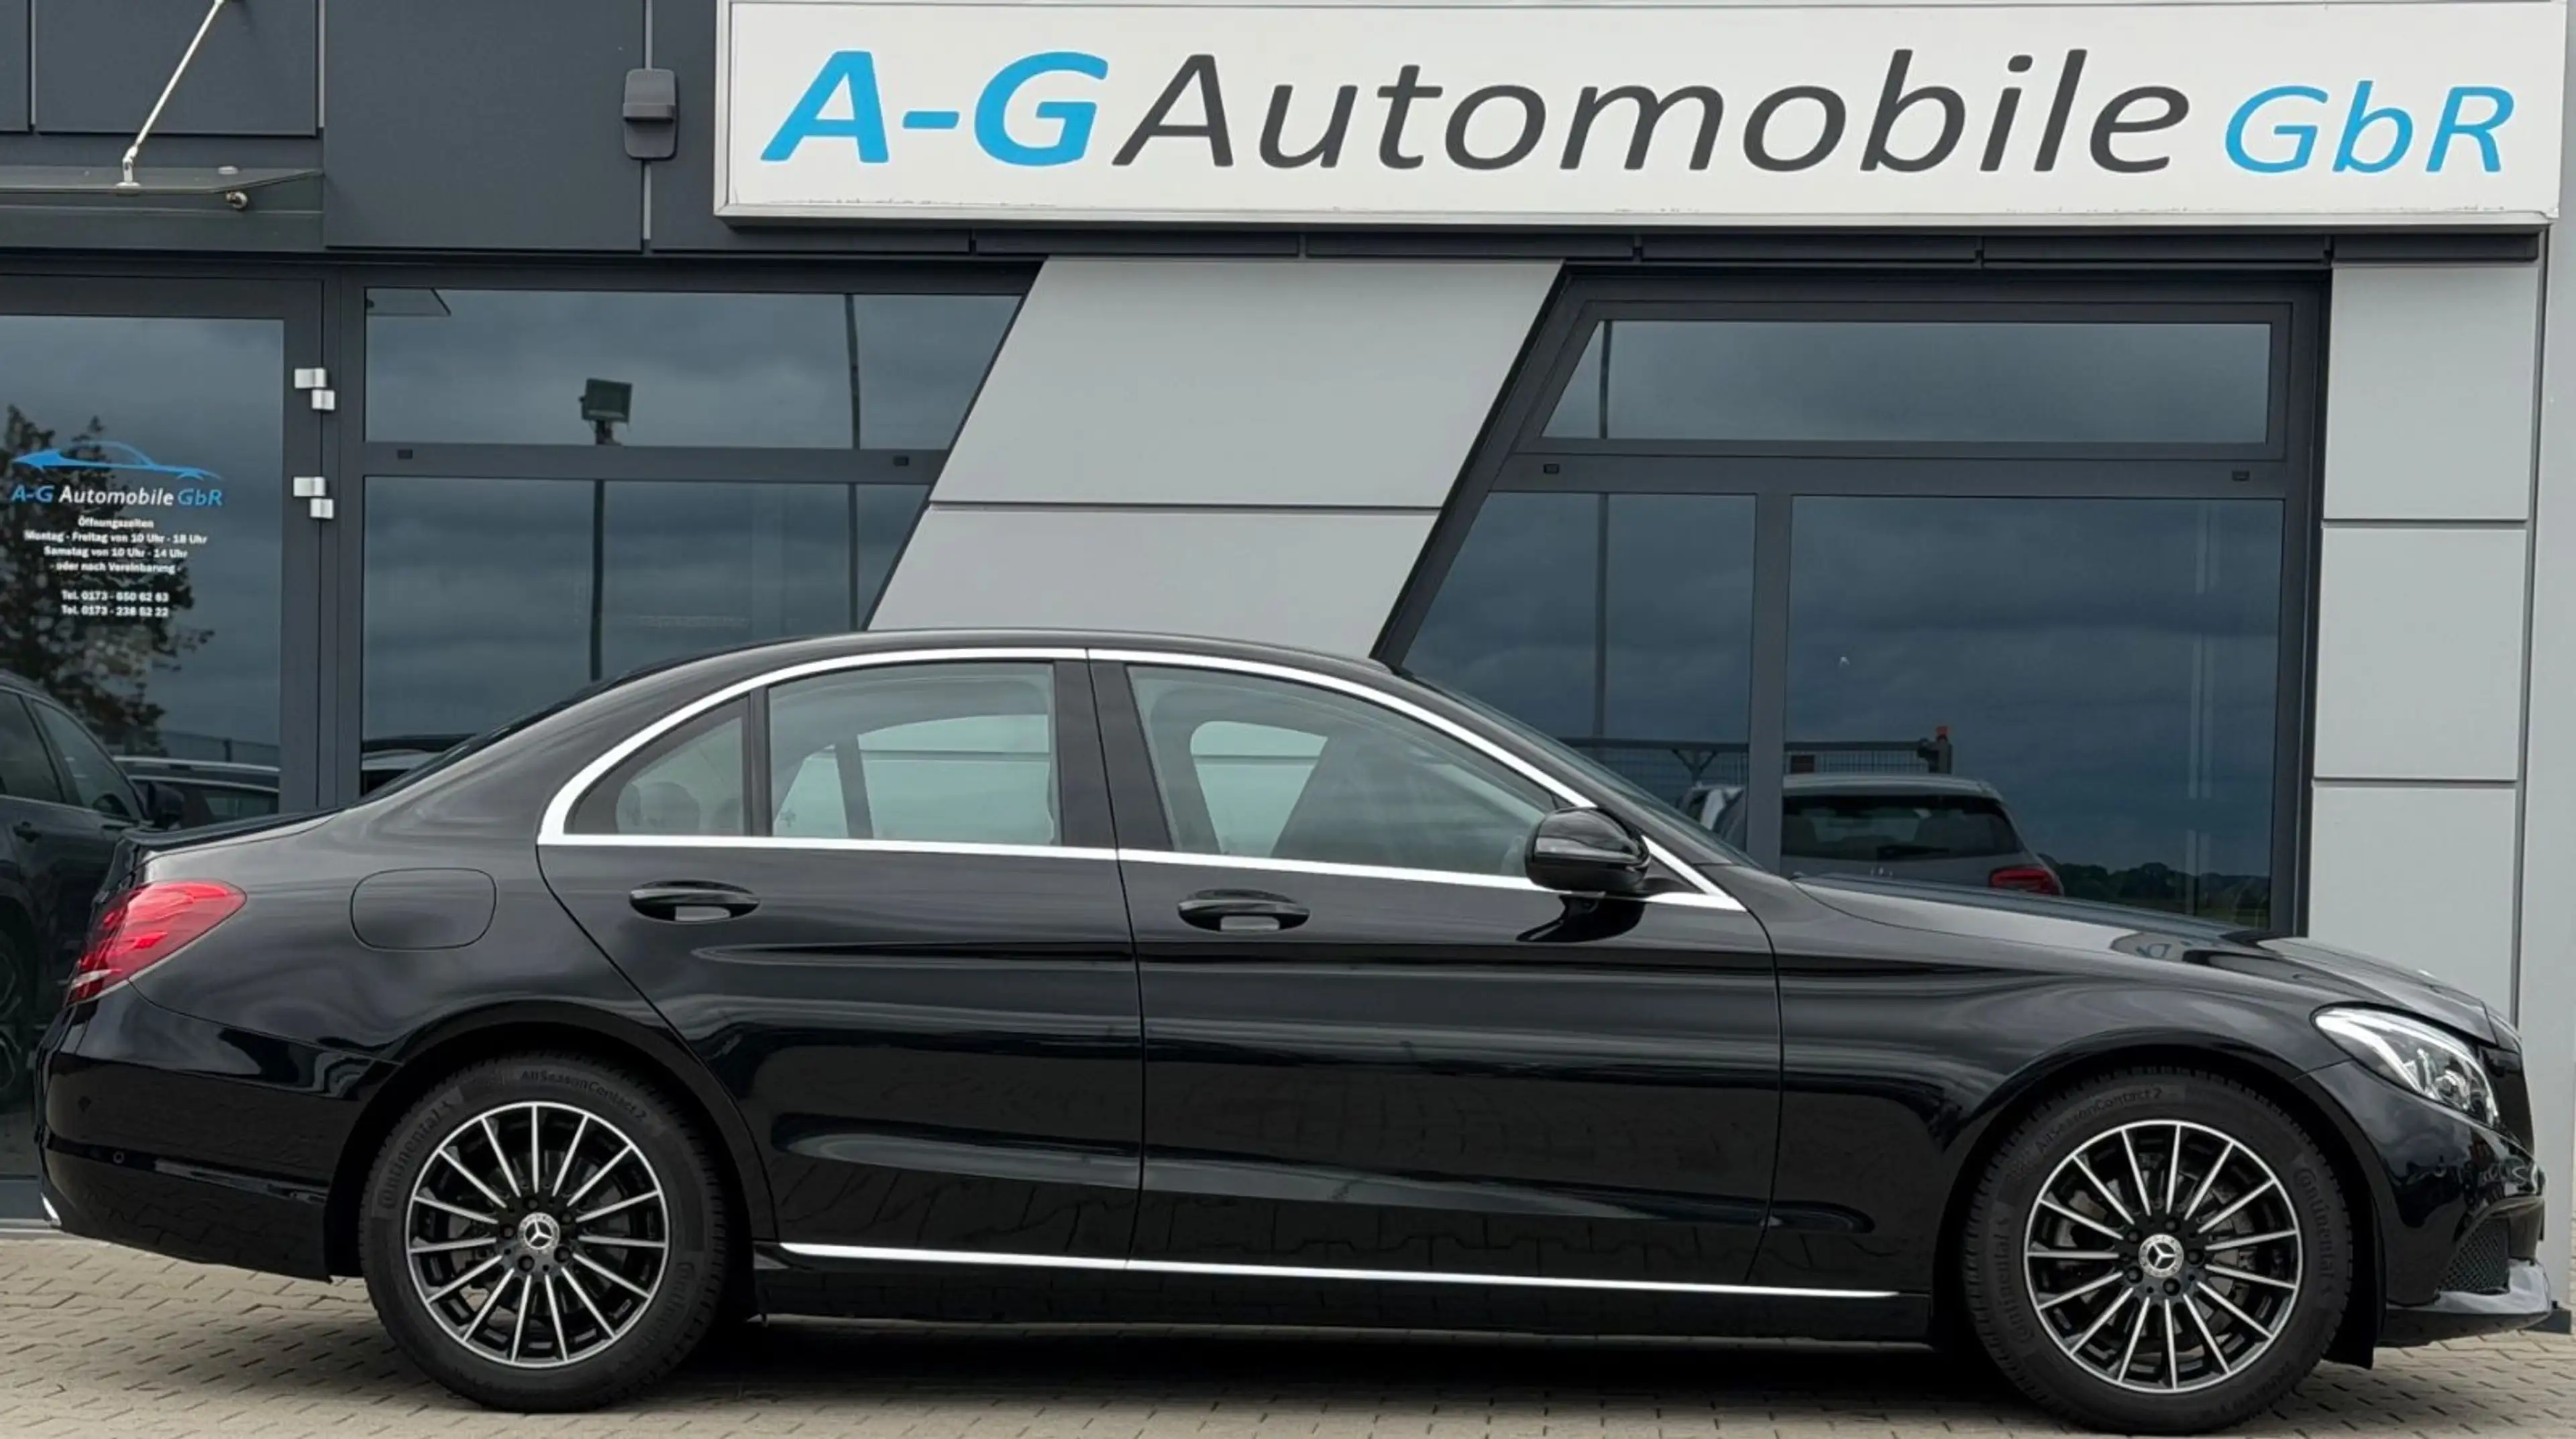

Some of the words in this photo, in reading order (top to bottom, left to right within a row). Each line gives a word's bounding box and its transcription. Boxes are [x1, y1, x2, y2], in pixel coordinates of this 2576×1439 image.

[761, 51, 1109, 166] A-G
[1112, 49, 2190, 174] Automobile
[2226, 80, 2514, 173] GbR
[11, 485, 55, 502] A-G
[58, 485, 174, 506] Automobile
[178, 488, 223, 507] GbR
[78, 515, 154, 529] Öffnungszeiten
[23, 530, 64, 543] Montag
[72, 531, 108, 544] Freitag
[110, 534, 128, 543] von
[131, 533, 144, 543] 10
[146, 533, 165, 543] Uhr
[172, 534, 186, 544] 18
[189, 534, 208, 545] Uhr
[44, 545, 89, 558] Samstag
[91, 549, 109, 557] von
[111, 547, 125, 557] 10
[127, 547, 145, 557] Uhr
[154, 548, 167, 558] 14
[169, 548, 188, 558] Uhr
[56, 561, 79, 571] oder
[80, 562, 106, 571] nach
[108, 562, 176, 575] Vereinbarung
[61, 590, 79, 601] Tel.
[80, 590, 109, 602] 0173
[61, 604, 79, 615] Tel.
[80, 605, 109, 616] 0173
[521, 1069, 638, 1115] AllSeasonContact
[378, 1107, 441, 1210] Continental
[2296, 1169, 2337, 1280] Continental
